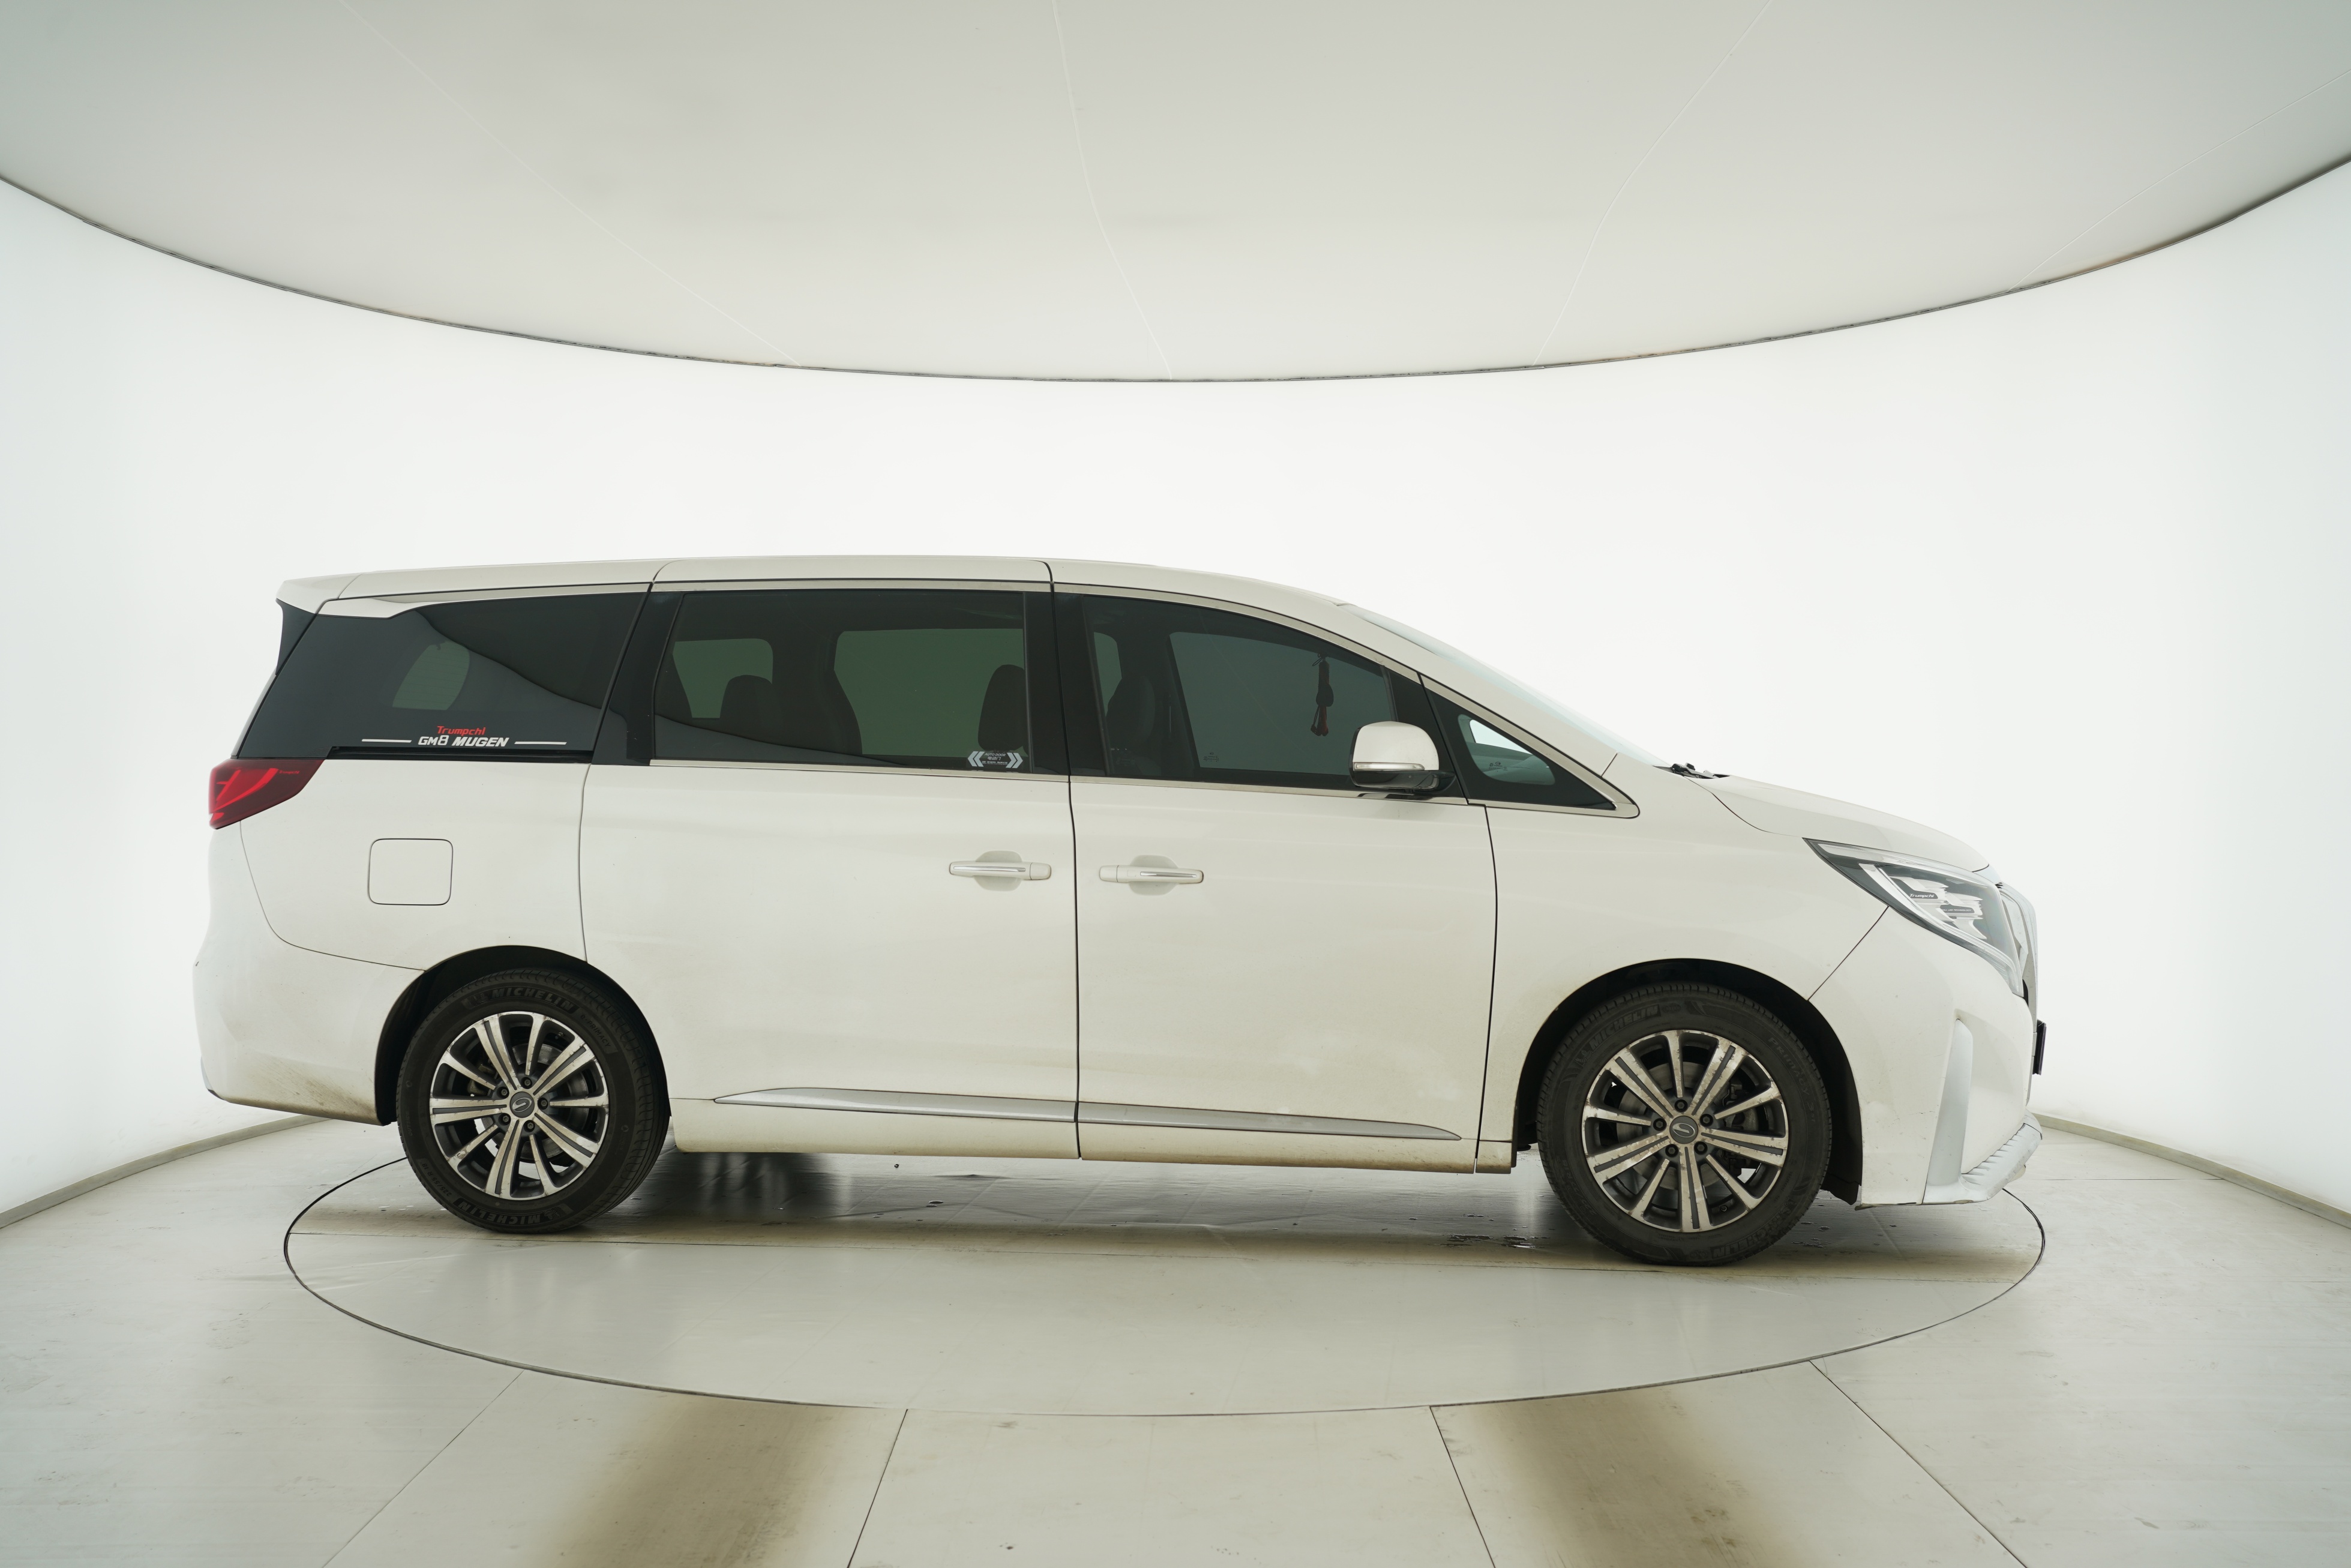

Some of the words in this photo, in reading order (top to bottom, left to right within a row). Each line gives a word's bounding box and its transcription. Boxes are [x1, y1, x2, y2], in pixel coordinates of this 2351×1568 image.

[418, 735, 449, 746] GM8
[451, 736, 510, 747] MUGEN
[491, 987, 574, 1011] MICHELIN
[1590, 1005, 1659, 1050] MICHELIN
[458, 1201, 540, 1225] MICHELIN
